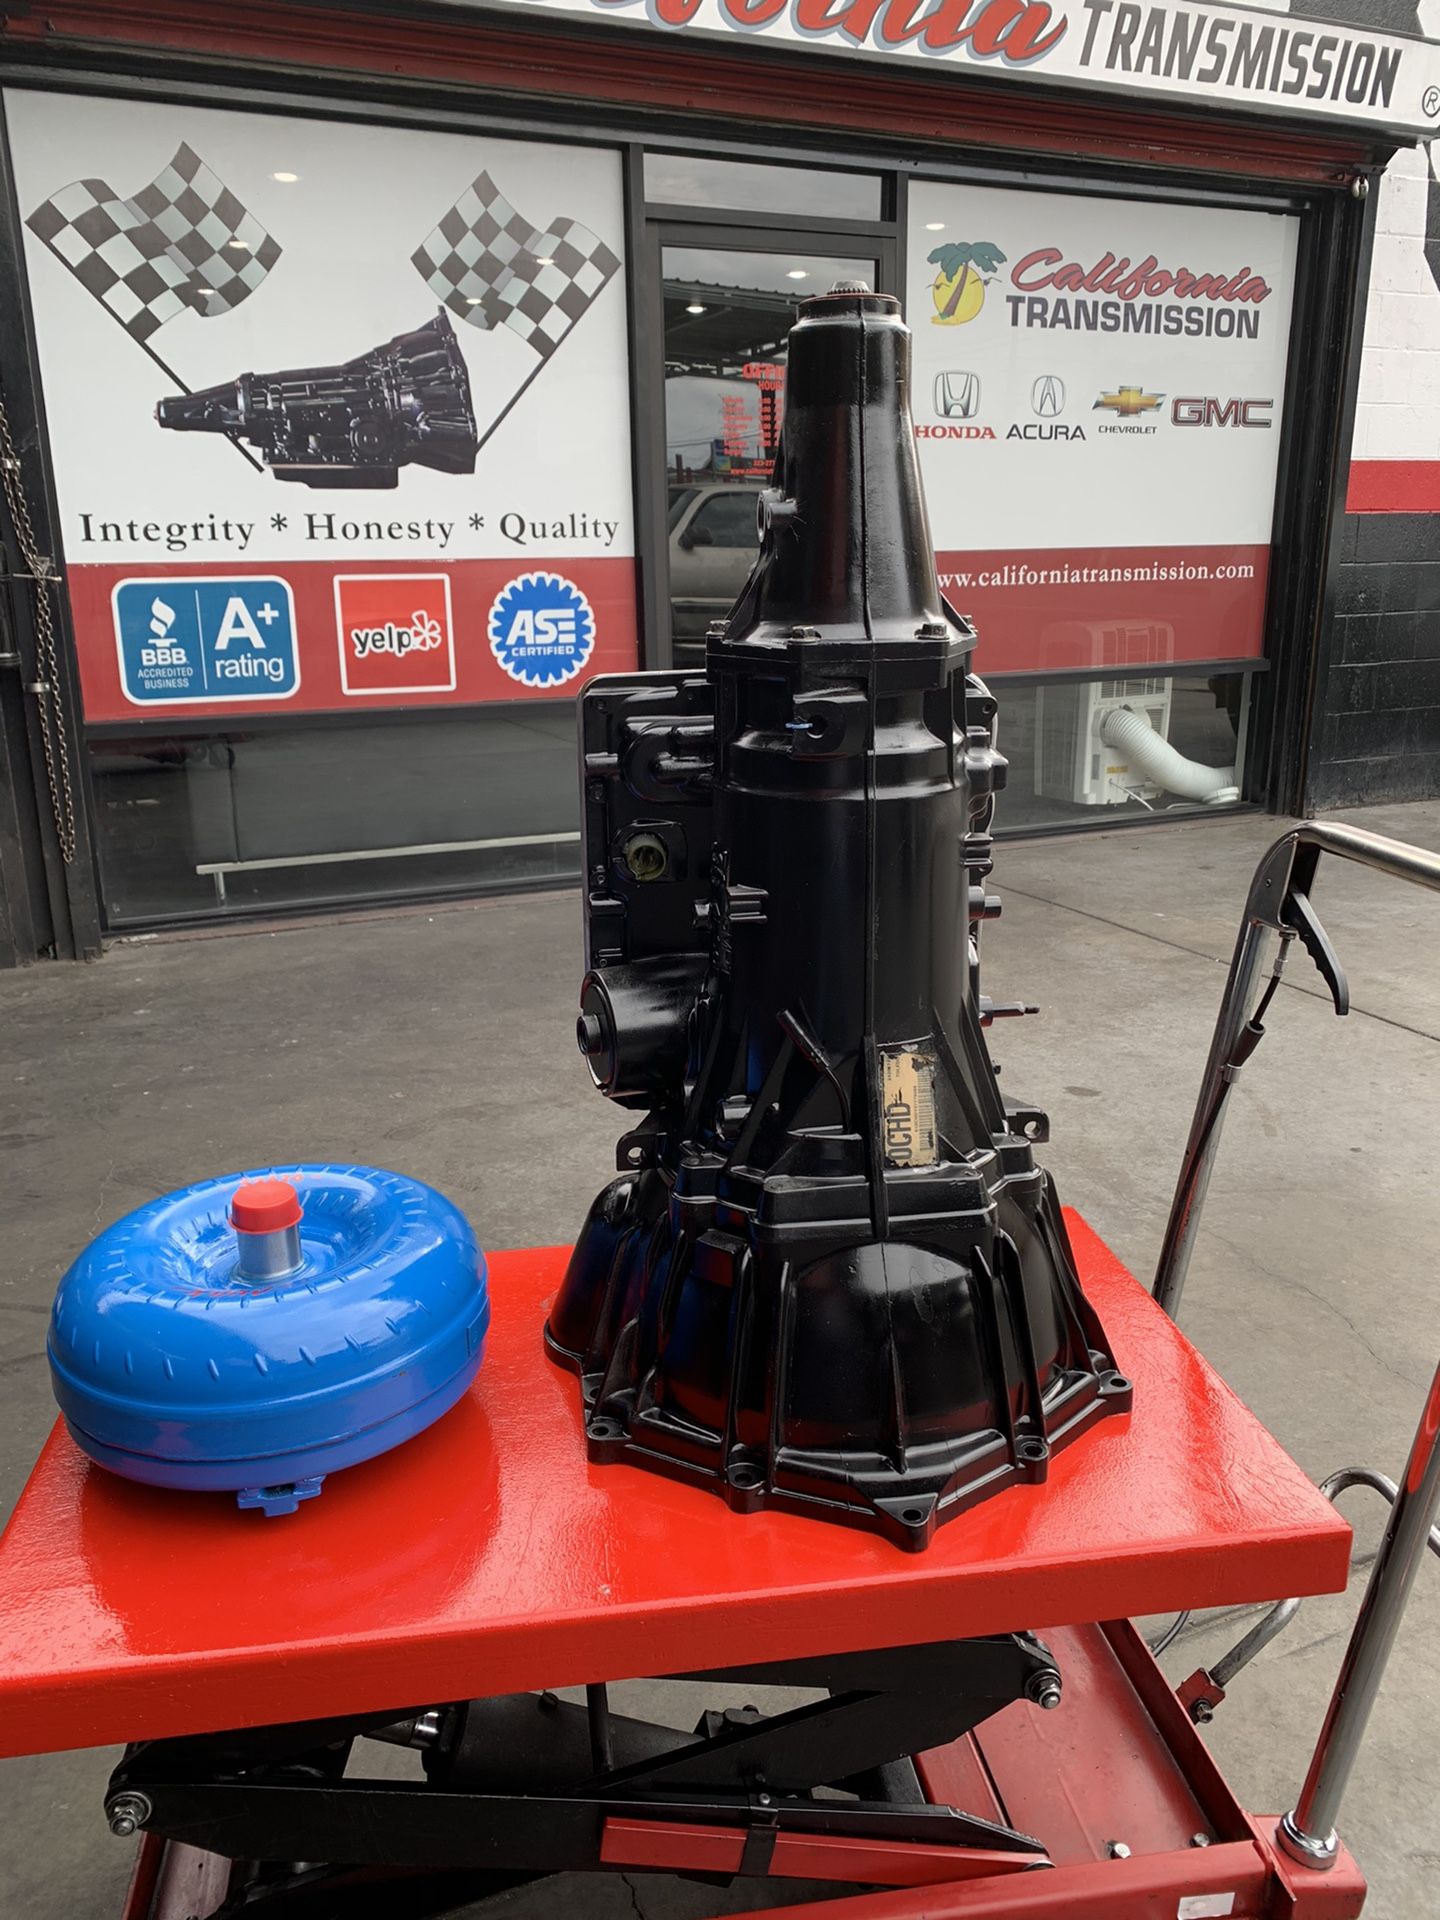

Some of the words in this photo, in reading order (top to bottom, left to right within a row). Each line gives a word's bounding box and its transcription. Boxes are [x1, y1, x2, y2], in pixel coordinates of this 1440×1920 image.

[1079, 0, 1403, 108] TRANSMISSION
[1010, 247, 1272, 304] California
[1006, 295, 1260, 339] TRANSMISSION
[1170, 396, 1274, 428] GMC
[914, 425, 997, 440] HONDA
[1006, 424, 1087, 441] ACURA
[1098, 425, 1157, 435] CHEVROLET
[79, 513, 256, 552] Integrity
[303, 513, 456, 548] Honesty
[499, 511, 621, 546] Quality
[937, 561, 1255, 588] ww.californiatransmission.com
[354, 625, 412, 655] yelp
[506, 609, 577, 646] ASE
[141, 648, 188, 666] BBB
[511, 646, 575, 657] CERTIFIED
[137, 667, 194, 679] ACCREDITED
[215, 653, 284, 682] rating
[144, 678, 190, 689] BUSINESS
